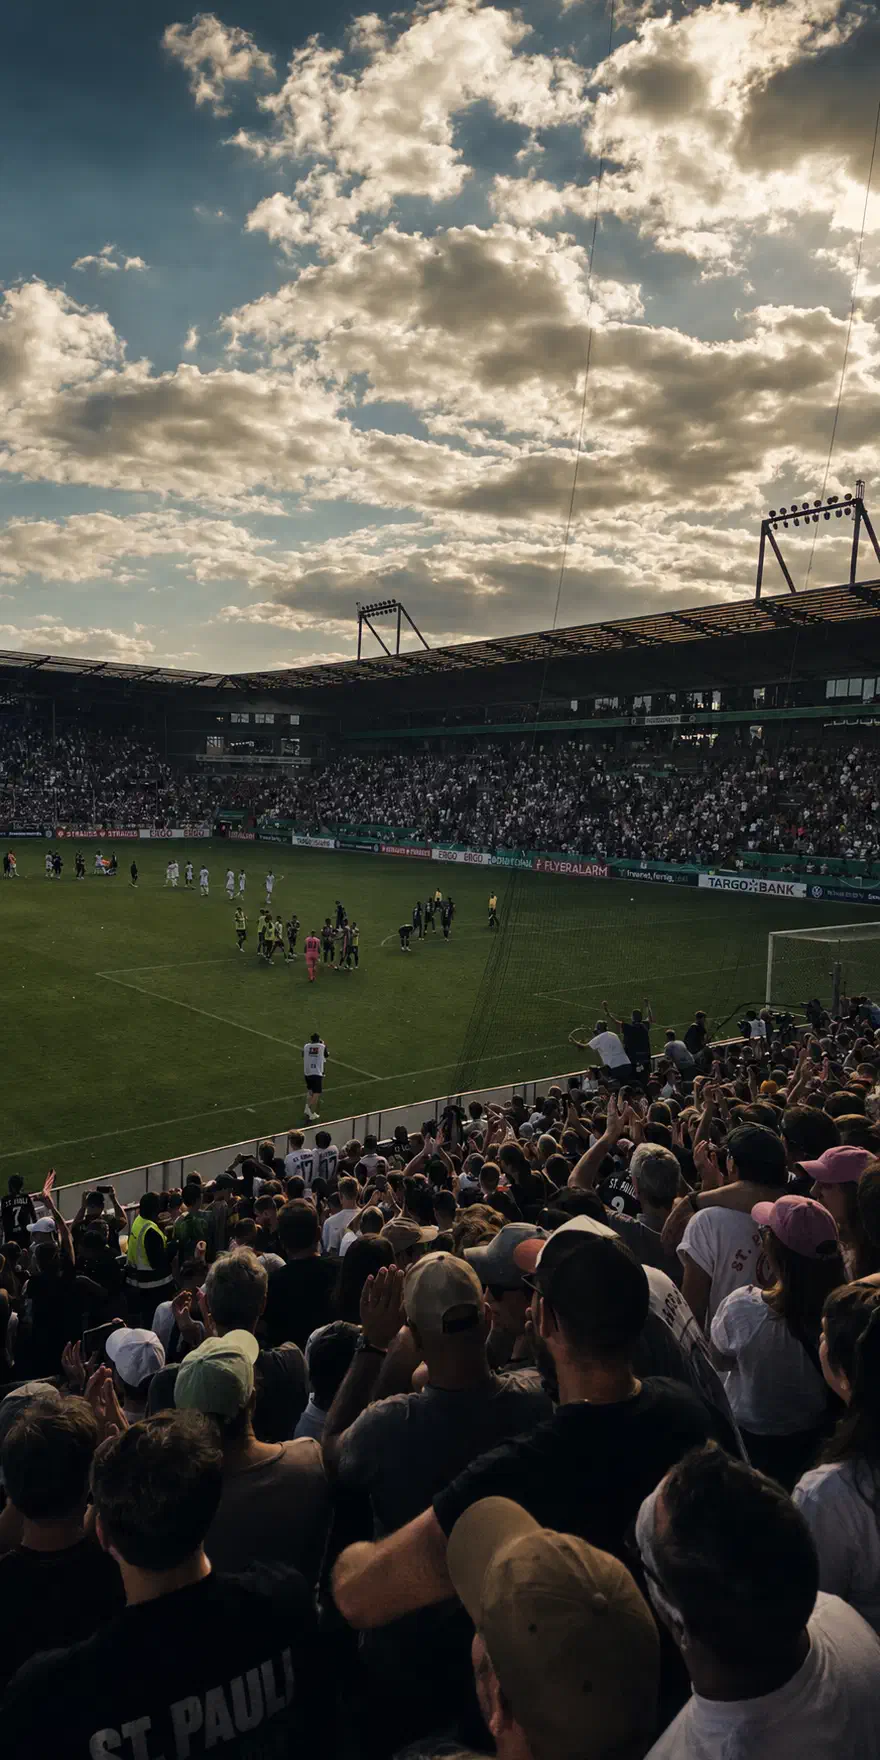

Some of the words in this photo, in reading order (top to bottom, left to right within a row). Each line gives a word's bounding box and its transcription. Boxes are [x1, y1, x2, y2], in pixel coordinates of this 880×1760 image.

[438, 851, 457, 860] ERGO
[463, 853, 483, 862] ERGO
[544, 860, 608, 877] FLYERALARM
[12, 1206, 22, 1227] 7
[731, 1249, 752, 1272] ST.
[88, 1715, 166, 1760] ST.
[169, 1645, 295, 1760] PAULI
